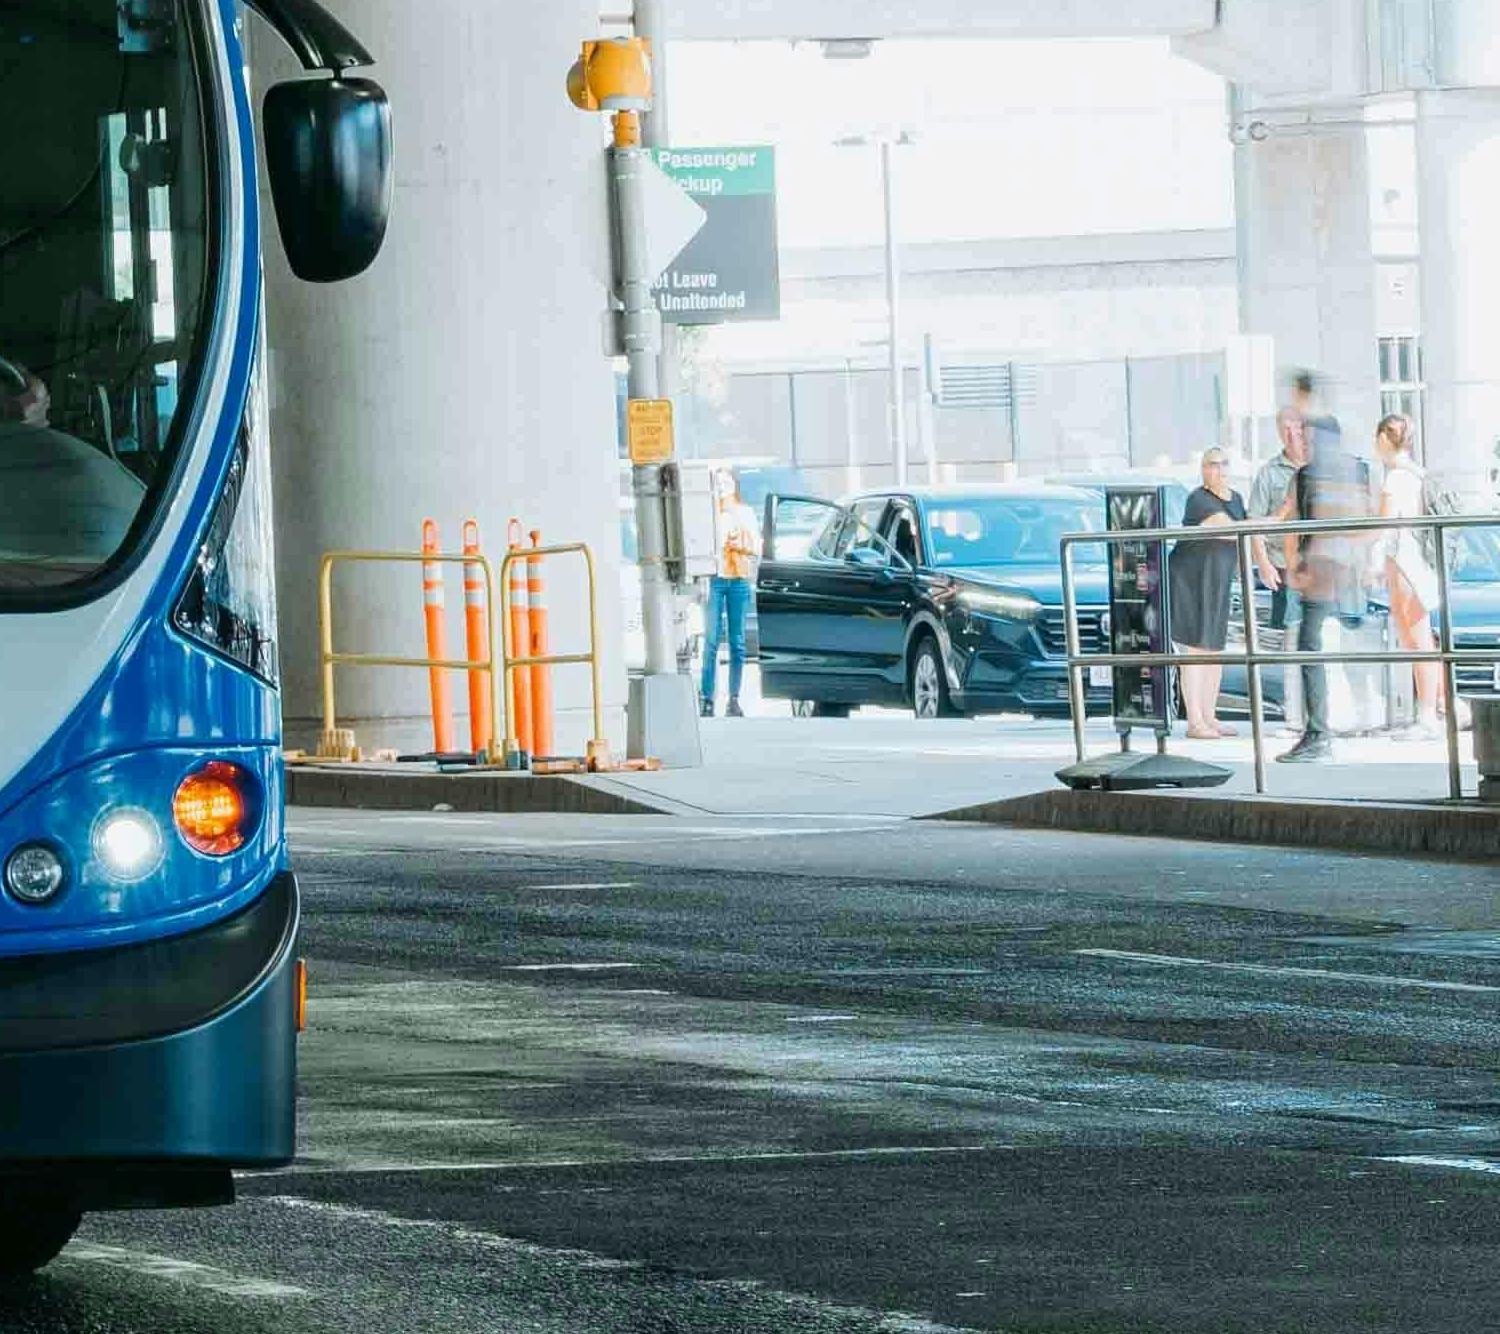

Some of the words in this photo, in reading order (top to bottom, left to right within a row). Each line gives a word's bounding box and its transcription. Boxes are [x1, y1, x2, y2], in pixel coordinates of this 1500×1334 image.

[659, 152, 756, 171] Passenger
[673, 271, 717, 288] Leave
[660, 291, 746, 310] Unattended
